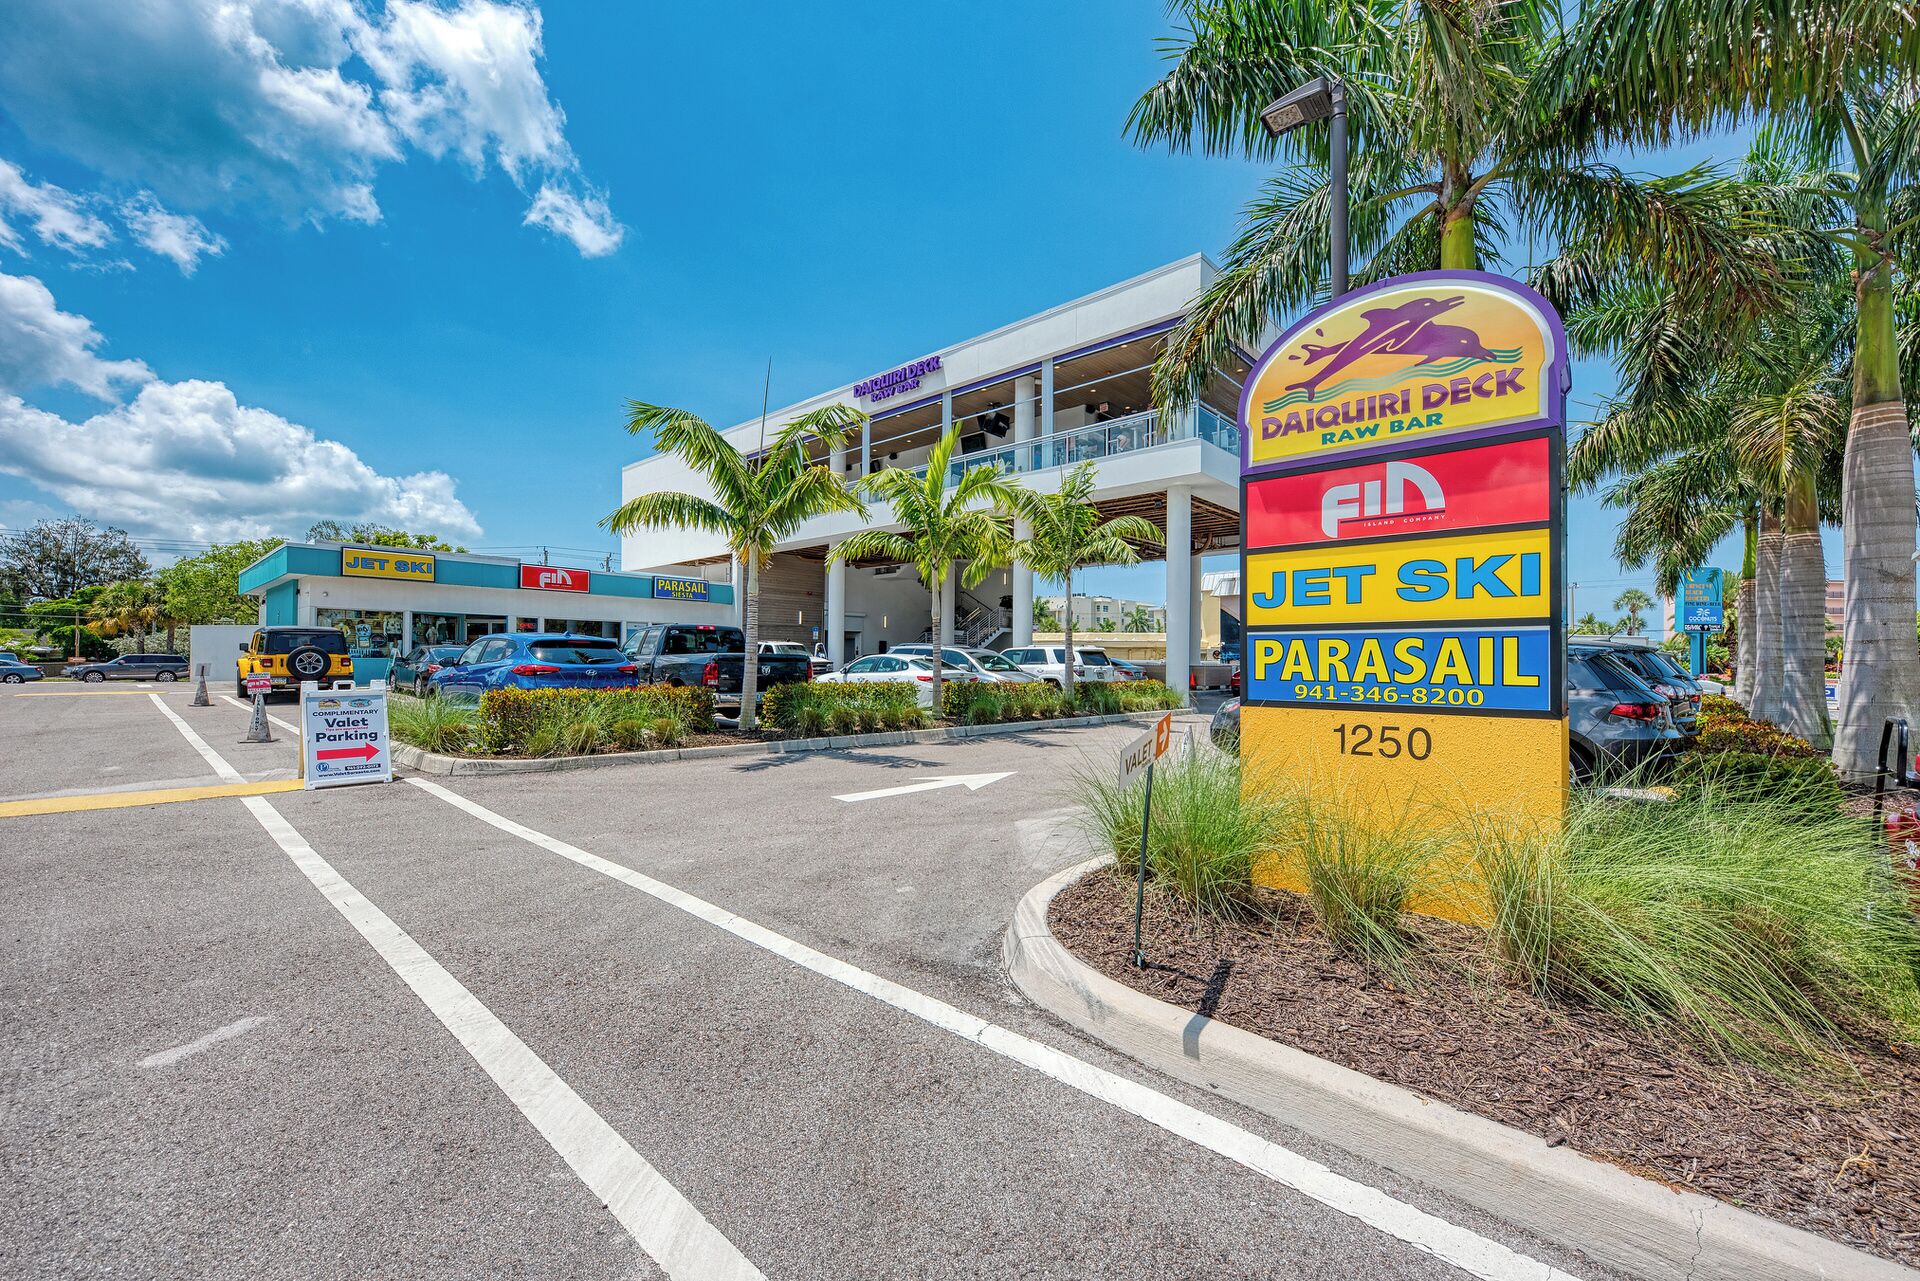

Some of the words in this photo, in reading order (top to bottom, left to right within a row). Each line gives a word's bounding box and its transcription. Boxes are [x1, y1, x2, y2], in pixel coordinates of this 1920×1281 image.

[853, 367, 907, 398] DAIQUIRI
[908, 355, 941, 379] DECK
[870, 386, 896, 402] RAW
[896, 379, 920, 393] BAR
[1261, 388, 1411, 441] DAIQUIRI
[1422, 367, 1525, 412] DECK
[1321, 423, 1380, 446] RAW
[1390, 412, 1443, 435] BAR
[1364, 519, 1395, 527] ISLAND
[1403, 514, 1446, 524] COMPANY
[345, 556, 389, 571] JET
[394, 560, 433, 574] SKI
[657, 579, 707, 593] PARASAIL
[1252, 564, 1377, 609] JET
[1395, 552, 1541, 602] SKI
[671, 591, 693, 599] SIESTA
[1254, 636, 1540, 687] PARASAIL
[1294, 684, 1485, 706] 941-346-8200
[312, 709, 379, 717] COMPLIMENTARY
[324, 717, 369, 728] Valet
[315, 730, 378, 742] Parking
[1333, 723, 1433, 761] 1250
[1125, 739, 1153, 775] VALET
